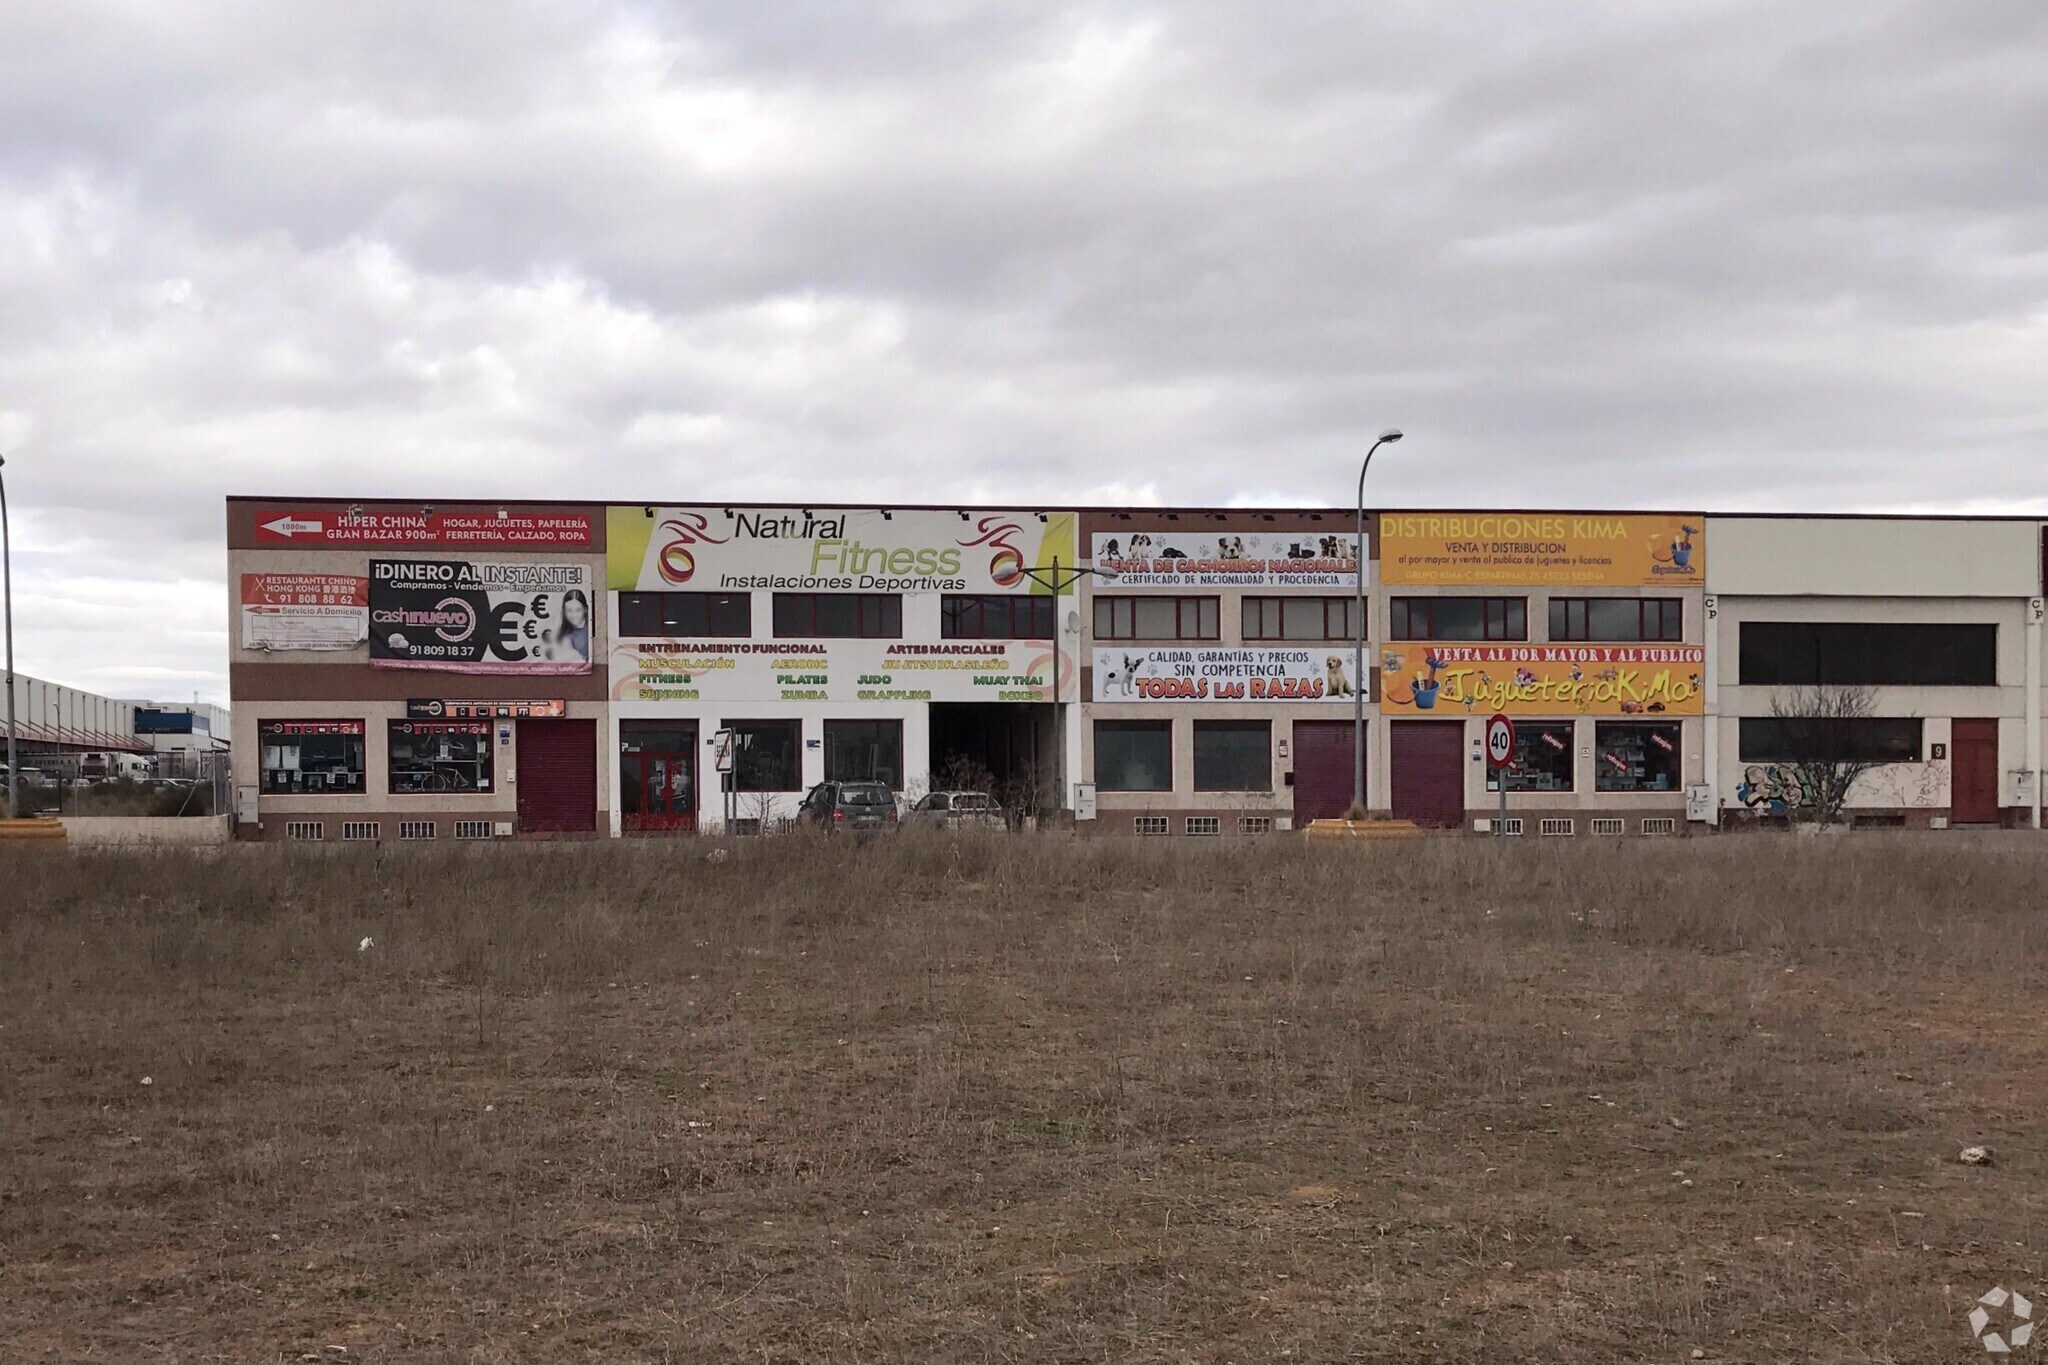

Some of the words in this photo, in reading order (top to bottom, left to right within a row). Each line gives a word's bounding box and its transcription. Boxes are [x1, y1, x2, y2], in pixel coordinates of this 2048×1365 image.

[338, 516, 378, 528] HIPER
[382, 516, 427, 528] CHINA
[443, 518, 481, 529] HOGAR,
[484, 518, 535, 529] JUGUETES,
[538, 517, 588, 529] PAPELERÍA
[734, 513, 846, 540] Natural
[1381, 518, 1566, 538] DISTRIBUCIONES
[1573, 518, 1628, 539] KIMA
[326, 529, 360, 539] GRAN
[364, 530, 403, 540] BAZAR
[446, 528, 505, 541] FERRETERÍA,
[508, 531, 557, 541] CALZADO,
[560, 532, 586, 540] ROPA
[1445, 542, 1479, 553] VENTA
[1482, 542, 1488, 553] Y
[1492, 542, 1566, 554] DISTRIBUCION
[810, 541, 962, 576] Fitness
[1408, 557, 1423, 566] por
[1425, 557, 1451, 566] mayor
[1452, 558, 1458, 566] y
[1460, 556, 1481, 564] venta
[1484, 556, 1492, 564] al
[1524, 556, 1535, 564] de
[1537, 556, 1570, 567] juguetes
[1152, 558, 1174, 574] DE
[1176, 558, 1266, 574] CACHORROS
[457, 566, 482, 582] AL
[484, 566, 583, 584] INSTANTE!
[1122, 574, 1180, 585] CERTIFICADO
[1184, 574, 1196, 584] DE
[1200, 574, 1264, 585] NACIONALIDAD
[1268, 574, 1274, 585] Y
[1278, 574, 1340, 585] PROCEDENCIA
[1405, 571, 1439, 581] GRUPO
[266, 577, 326, 586] RESTAURANTE
[328, 578, 357, 586] CHINO
[720, 573, 853, 590] Instalaciones
[858, 575, 966, 593] Deportivas
[266, 584, 293, 593] HONG
[296, 585, 321, 593] KONG
[390, 581, 447, 591] Compramos
[454, 582, 504, 592] Vendemos
[510, 582, 567, 594] Empeñamos
[280, 595, 292, 604] 91
[298, 596, 317, 604] 808
[322, 596, 335, 604] 88
[340, 596, 353, 604] 62
[282, 607, 315, 615] Servicio
[324, 608, 362, 616] Domicilio
[446, 646, 458, 656] 18
[460, 646, 475, 657] 37
[638, 643, 752, 654] ENTRENAMIENTO
[752, 644, 827, 654] FUNCIONAL
[886, 644, 928, 654] ARTES
[930, 645, 1006, 655] MARCIALES
[1198, 650, 1254, 663] GARANTÍAS
[1258, 653, 1266, 663] Y
[1268, 652, 1309, 664] PRECIOS
[1432, 648, 1484, 662] VENTA
[1487, 648, 1507, 662] AL
[1511, 648, 1539, 662] POR
[1544, 648, 1599, 662] MAYOR
[1603, 648, 1613, 662] Y
[1618, 649, 1637, 662] AL
[1641, 649, 1703, 663] PUBLICO
[638, 657, 735, 669] MUSCULACIÓN
[770, 659, 828, 670] AEROBIC
[882, 660, 900, 670] JIU
[902, 660, 936, 670] JITSU
[937, 658, 1010, 671] BRASILEÑO
[1174, 664, 1196, 677] SIN
[1202, 664, 1286, 677] COMPETENCIA
[638, 674, 692, 684] FITNESS
[776, 674, 828, 685] PILATES
[857, 675, 892, 685] JUDO
[973, 676, 1010, 686] MUAY
[1136, 677, 1208, 699] TODAS
[1213, 682, 1245, 699] LAS
[1249, 677, 1324, 700] RAZAS
[638, 689, 700, 700] SPINNING
[780, 690, 828, 700] ZUMBA
[857, 690, 932, 700] GRAPPLING
[998, 690, 1043, 701] BOXEO
[1491, 732, 1508, 750] 40
[1935, 746, 1942, 758] 9
